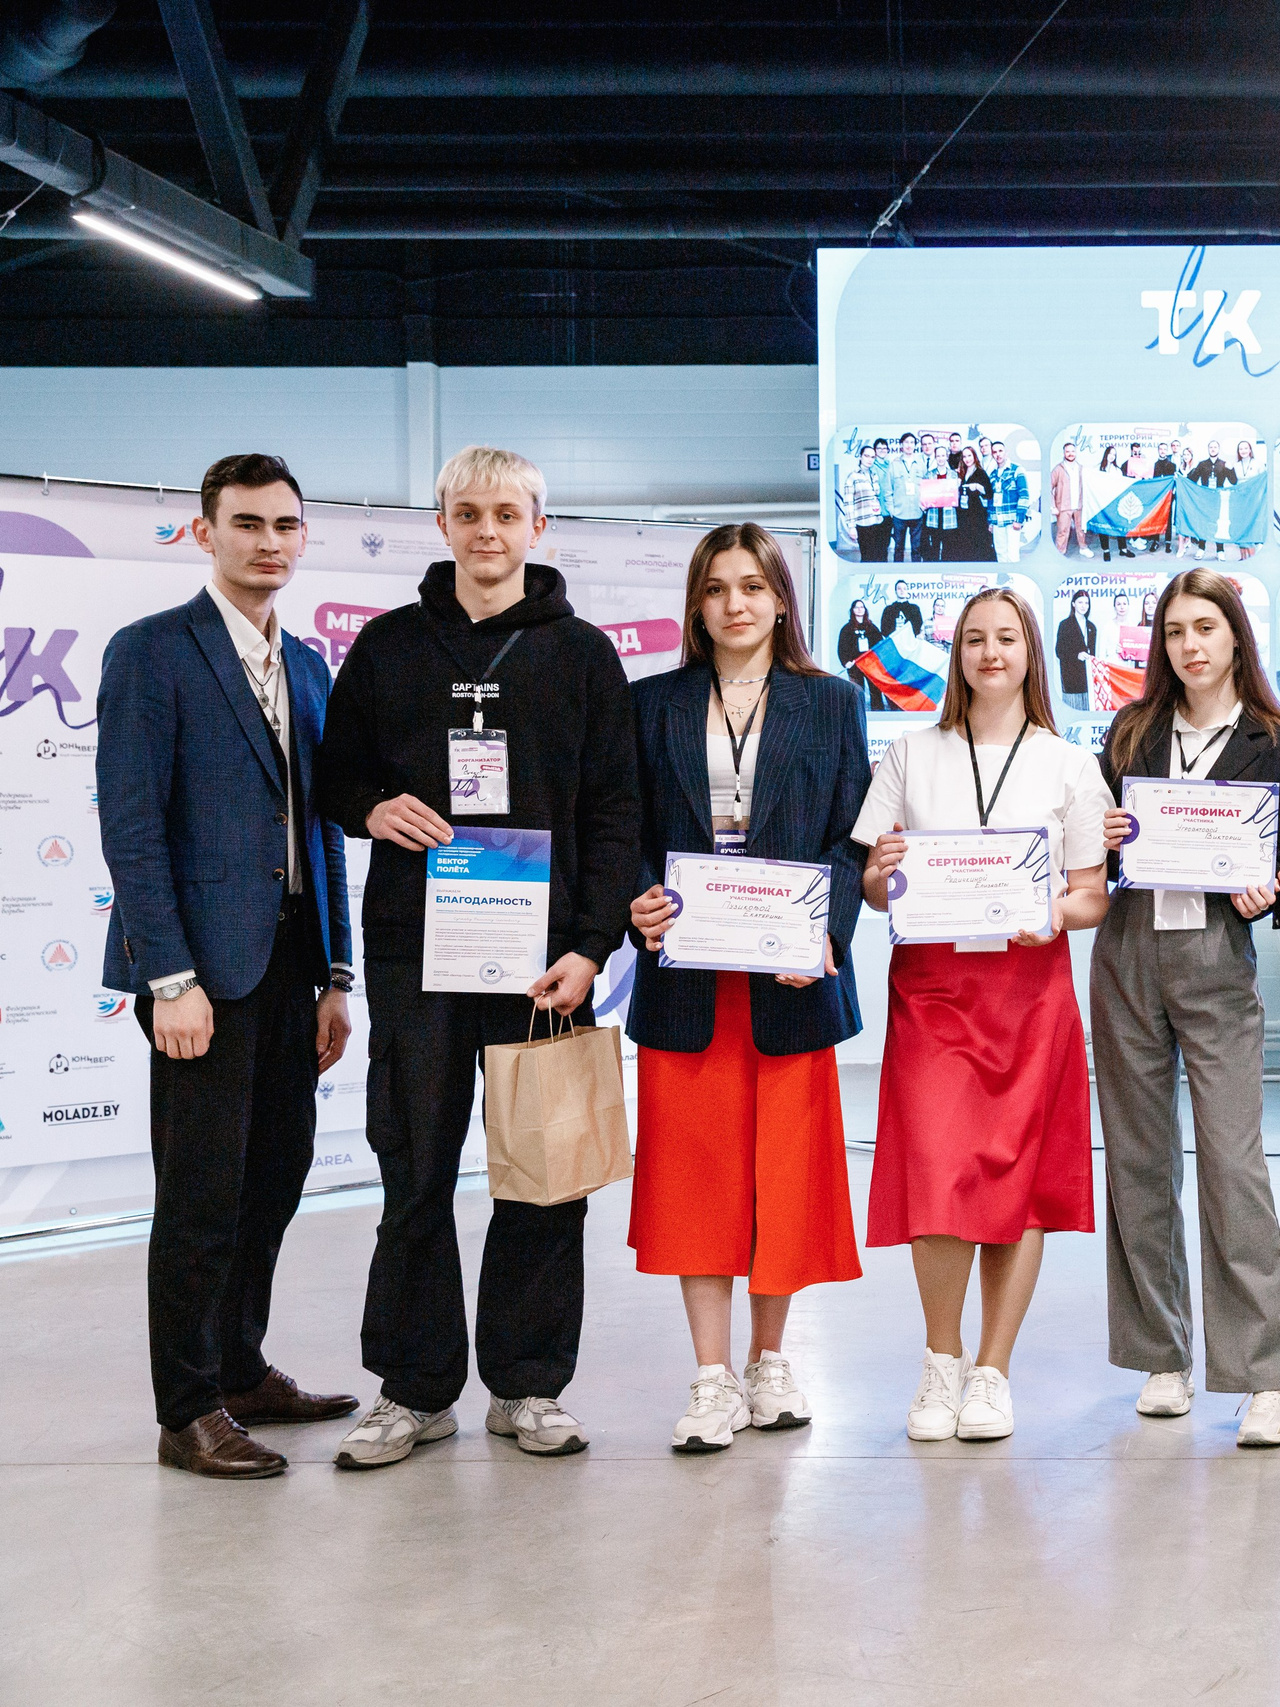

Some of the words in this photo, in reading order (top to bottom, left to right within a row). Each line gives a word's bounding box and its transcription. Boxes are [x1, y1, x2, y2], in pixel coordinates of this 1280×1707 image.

[906, 582, 965, 590] ЕРРИТОРИЯ
[452, 683, 500, 692] CAPTAINS
[1160, 806, 1242, 818] СЕРТИФИКАТ
[437, 857, 469, 865] ВЕКТОР
[927, 856, 1012, 867] СЕРТИФИКАТ
[436, 865, 470, 874] ПОЛЁТА
[705, 882, 792, 898] СЕРТИФИКАТ
[436, 895, 532, 906] БЛАГОДАРНОСТЬ
[43, 1104, 120, 1123] MOLADZ.BY
